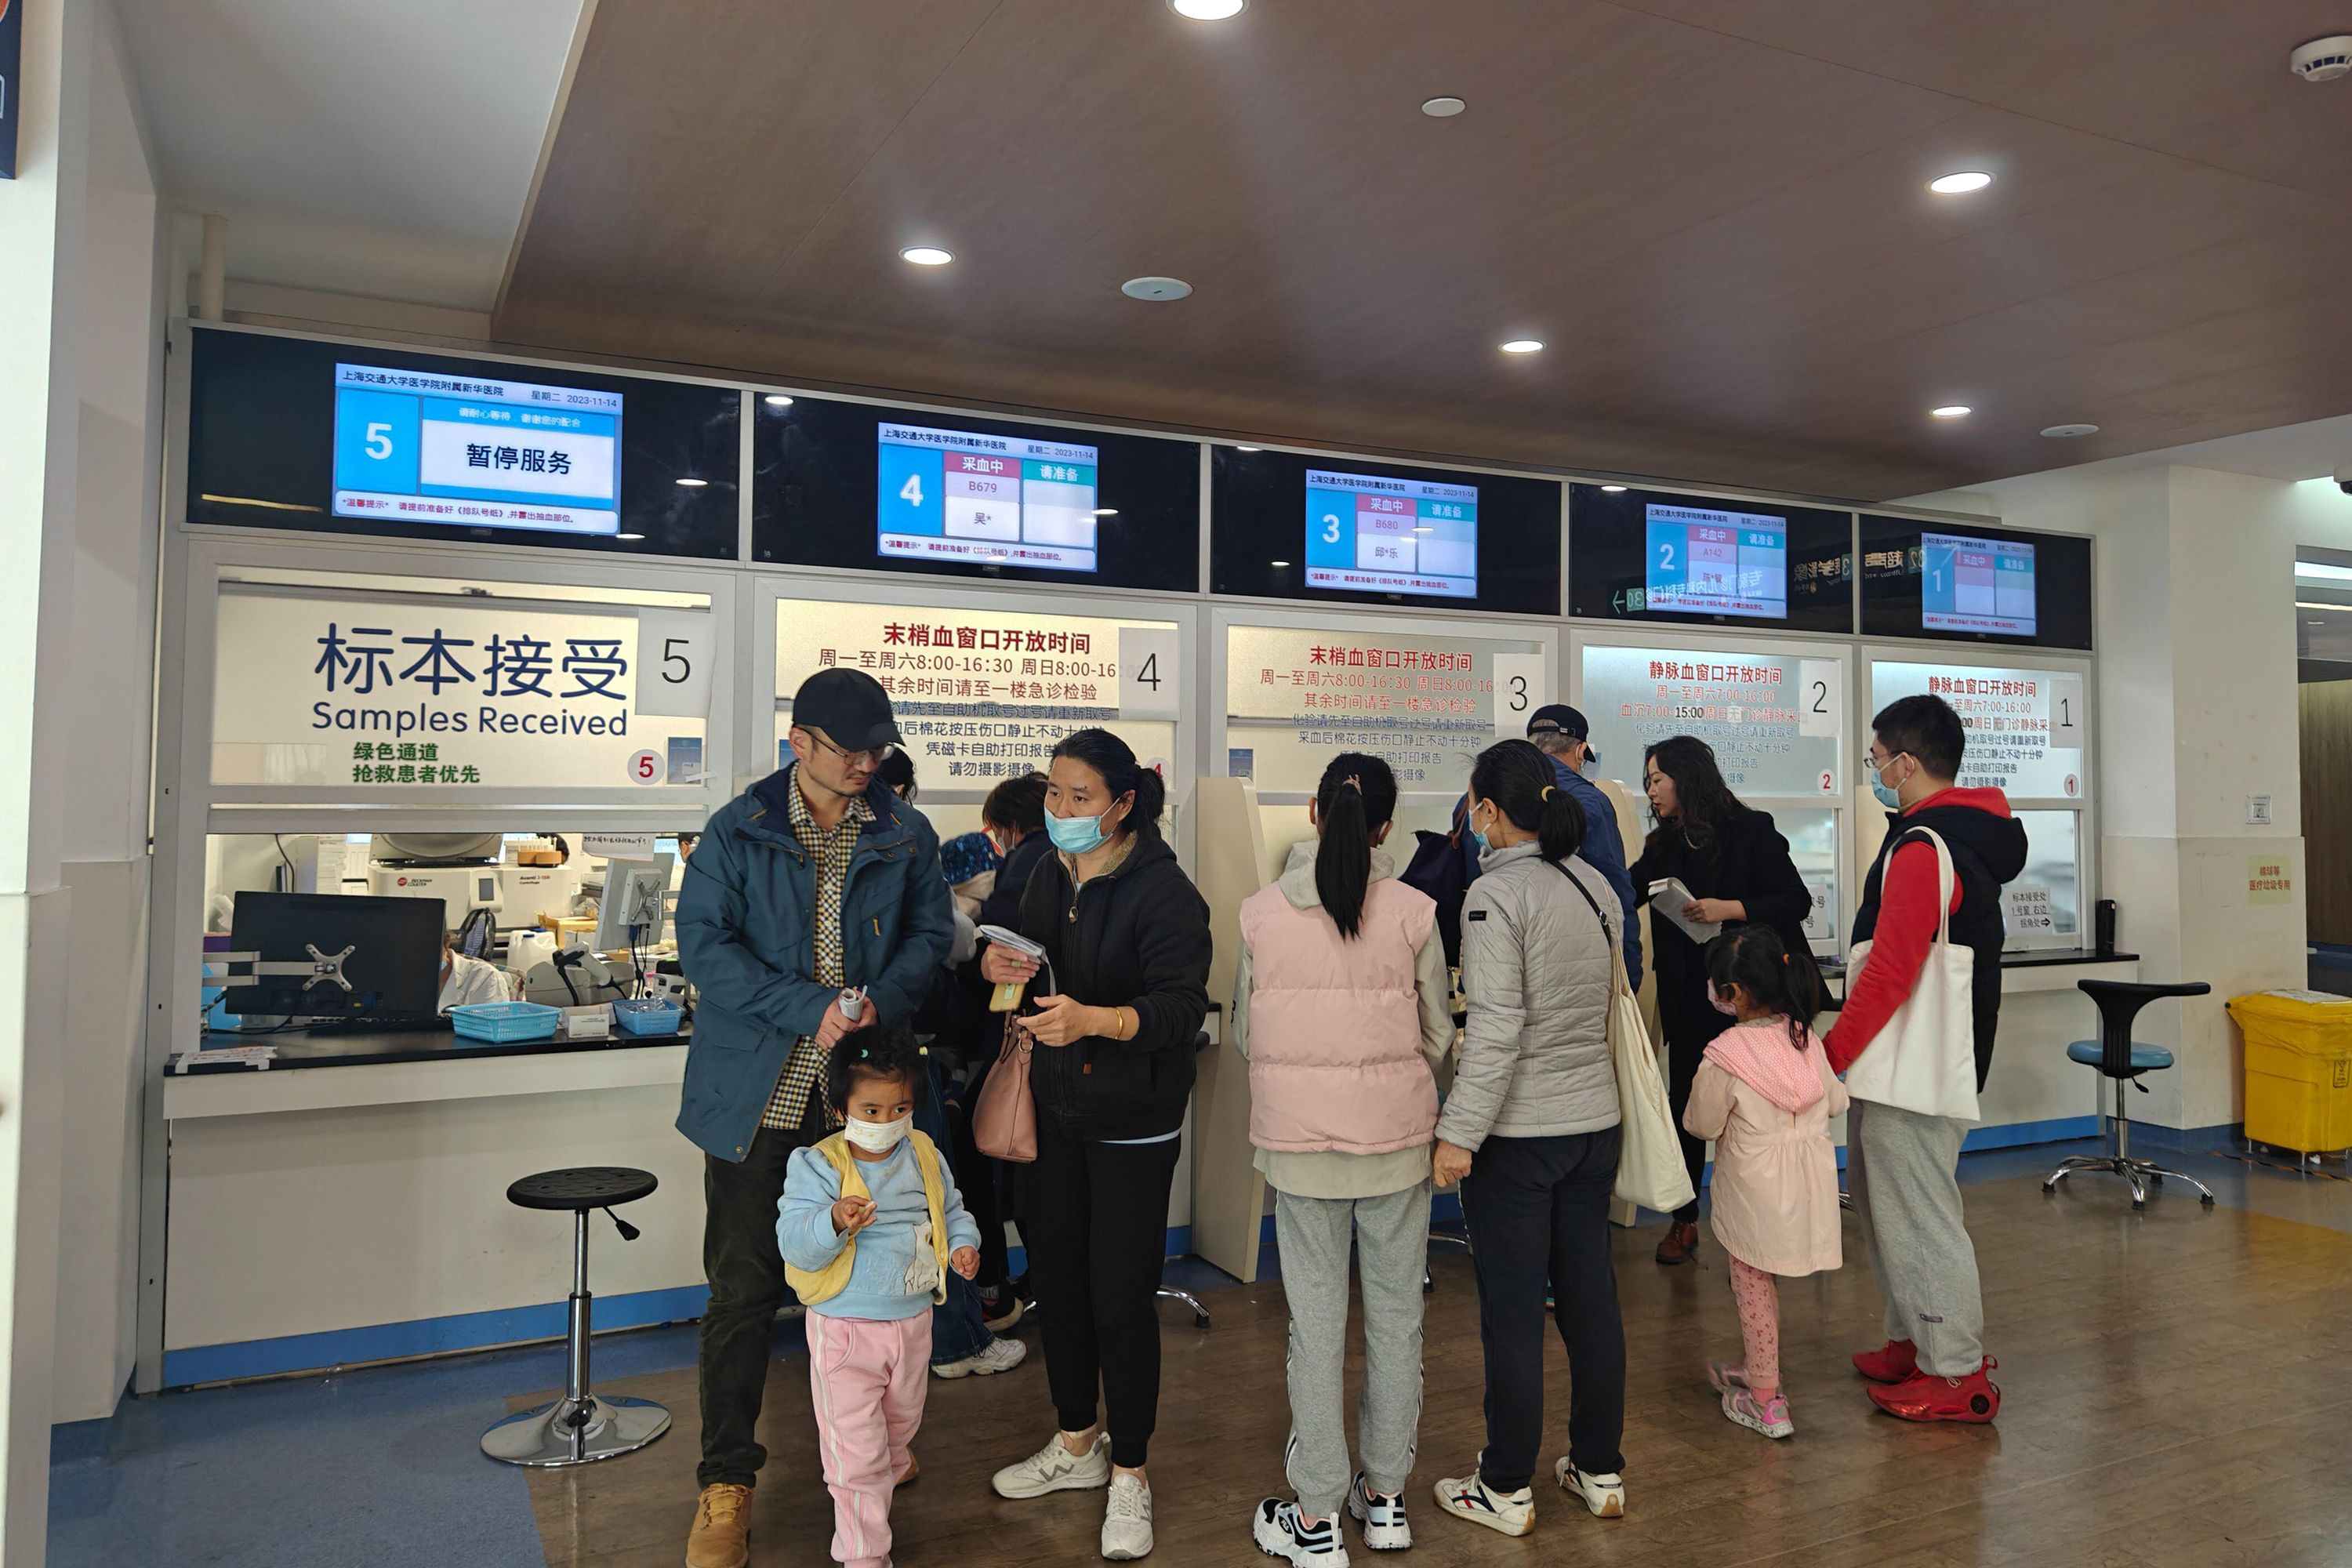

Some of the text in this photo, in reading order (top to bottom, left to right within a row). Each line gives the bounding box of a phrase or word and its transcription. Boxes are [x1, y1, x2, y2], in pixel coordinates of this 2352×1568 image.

[343, 370, 504, 397] 上海交通大学医学院附属新华医院
[531, 390, 617, 408] 星期二 2023-11-14
[365, 423, 393, 460] 5
[883, 429, 1007, 450] 上海交通大学医学院附属新华医院
[467, 443, 572, 475] 暂停服务
[1028, 445, 1093, 459] 星期二 2023-11-14
[962, 456, 1004, 474] 采血中
[1040, 464, 1079, 482] 请准备
[900, 474, 924, 506] 4
[969, 481, 997, 493] B679
[1370, 498, 1403, 514] 采血中
[1432, 503, 1462, 519] 请准备
[1322, 514, 1341, 543] 3
[1376, 520, 1398, 530] B680
[1699, 528, 1726, 541] 采血中
[1660, 543, 1675, 570] 2
[1933, 569, 1941, 592] 1
[883, 622, 1091, 655] 末梢血窗口开放时间
[314, 622, 628, 701] 标本接受
[661, 638, 691, 684] 5
[818, 648, 1013, 674] 周一至周六8:00-16:30
[1309, 646, 1473, 673] 末梢血窗口开放时间
[1137, 653, 1161, 691] 4
[1260, 668, 1411, 691] 周一至周六8:00-16:30
[1649, 661, 1783, 686] 静脉血窗口开放时间
[879, 676, 1098, 701] 其余时间请至一楼急诊检验
[1509, 676, 1528, 711] 3
[1656, 684, 1776, 703] 周一至周六7:00-16:00
[1813, 681, 1828, 713] 2
[1928, 676, 2037, 698] 静脉血窗口开放时间
[1305, 691, 1476, 714] 其余时间请至一楼急诊检验
[2061, 698, 2073, 727] 1
[312, 702, 628, 738] Samples Received
[354, 742, 439, 762] 绿色通道
[353, 764, 481, 784] 抢救患者优先
[638, 757, 654, 779] 5
[949, 761, 1035, 777] 请勿摄影摄像
[1822, 774, 1831, 789] 2
[2068, 779, 2074, 793] 1
